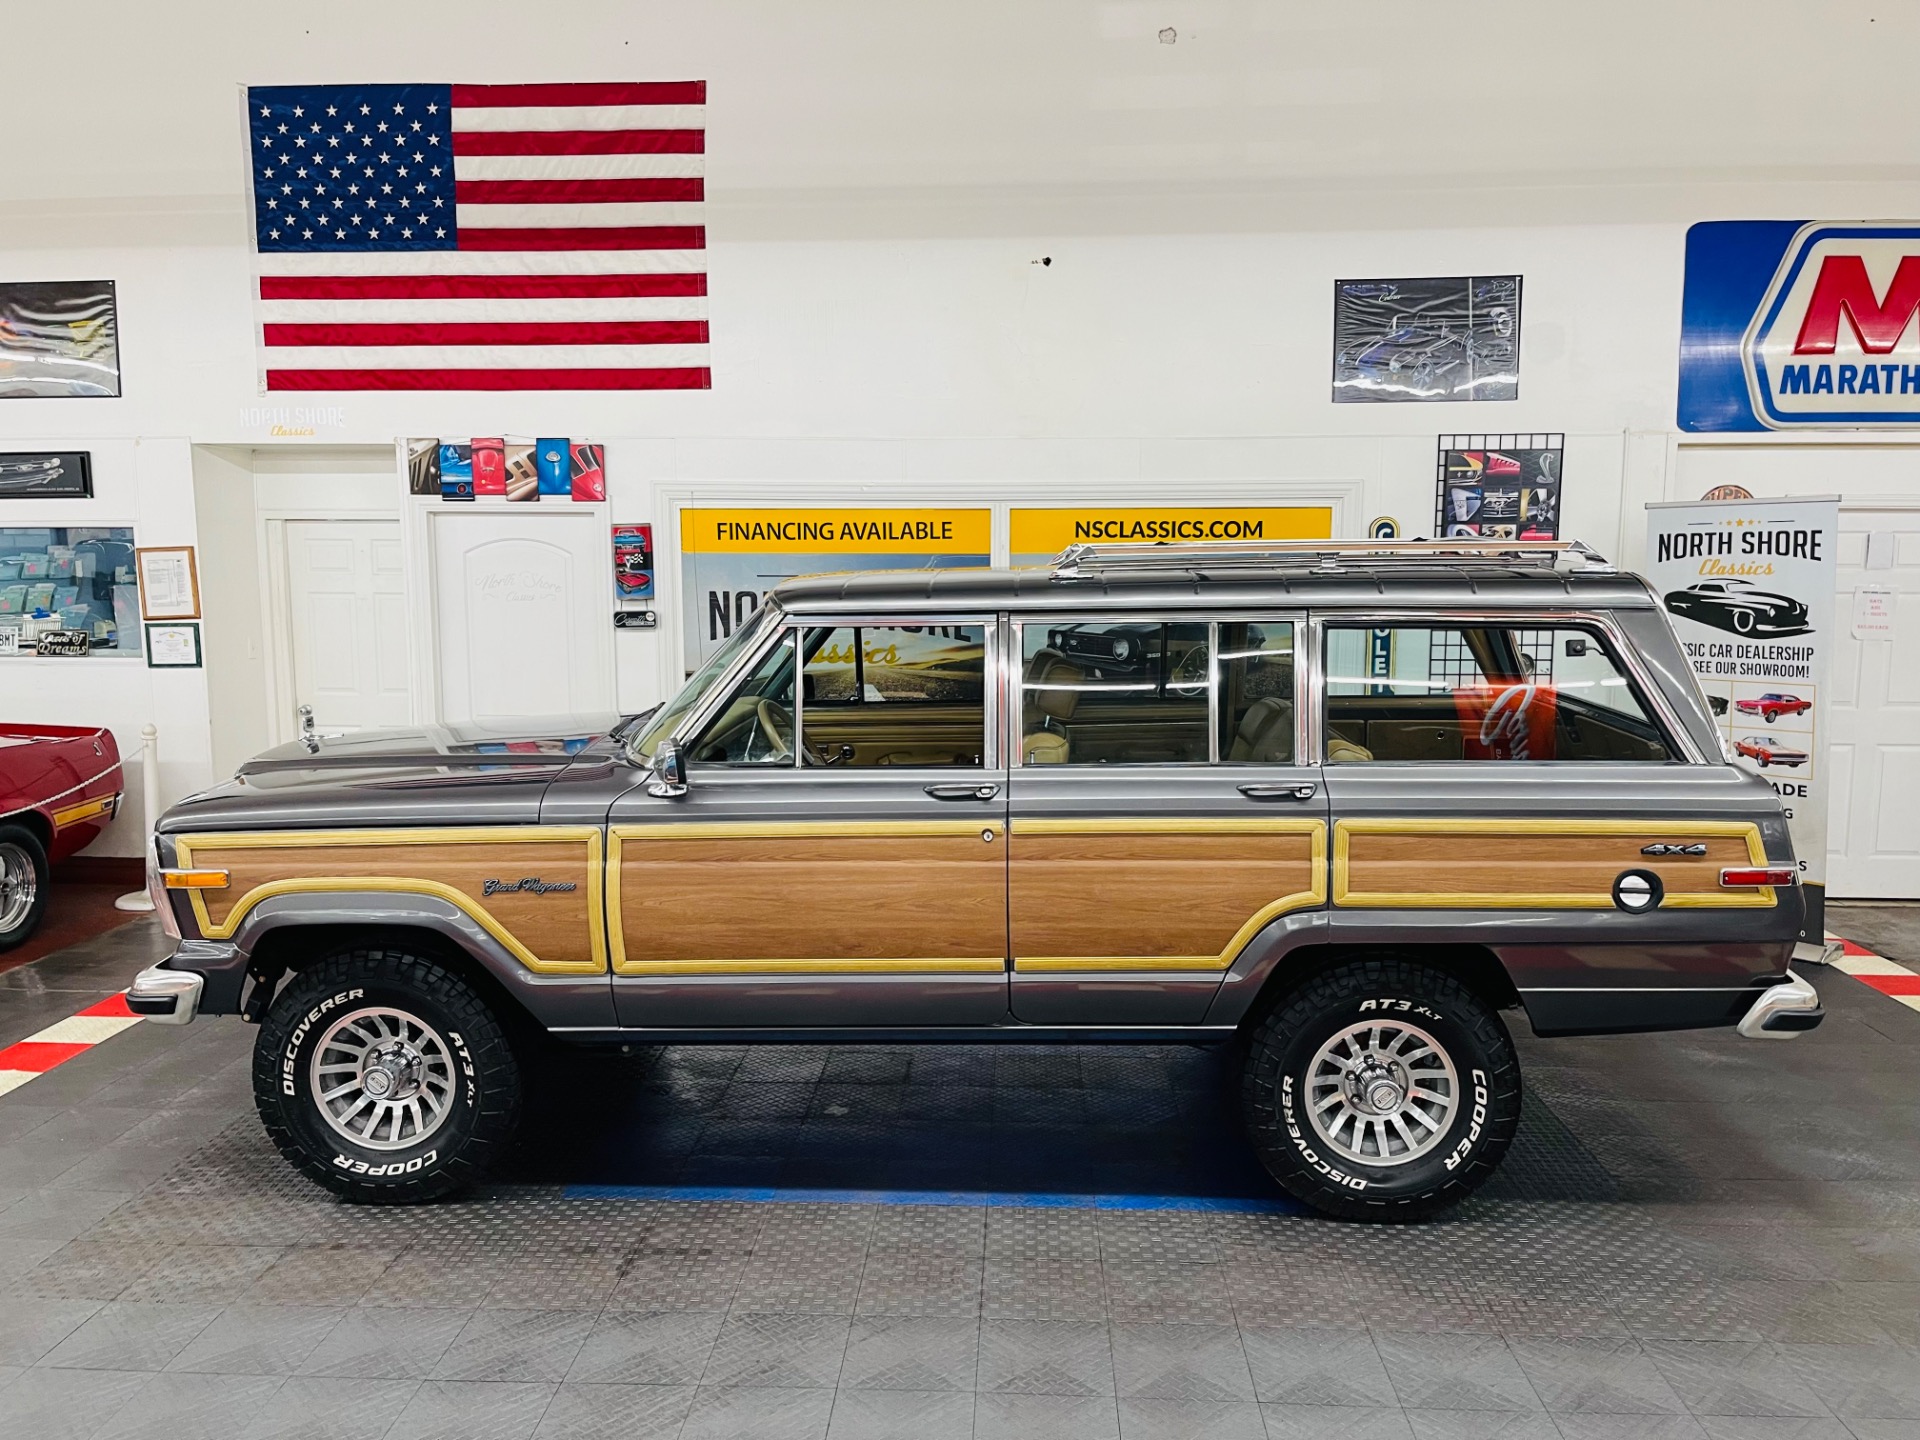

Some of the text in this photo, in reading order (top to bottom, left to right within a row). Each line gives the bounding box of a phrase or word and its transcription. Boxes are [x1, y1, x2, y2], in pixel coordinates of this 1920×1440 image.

[239, 406, 346, 428] NORTH SHORE
[270, 425, 316, 437] Classics
[716, 521, 953, 541] FINANCING AVAILABLE
[1075, 520, 1263, 539] NSCLASSICS.COM
[1657, 529, 1823, 563] NORTH SHORE
[1698, 558, 1776, 576] Classics
[38, 643, 87, 655] Dreams
[1709, 643, 1733, 659] CAR
[1736, 645, 1815, 662] DEALERSHIP
[1693, 660, 1810, 679] SEE OUR SHOWROOM!
[482, 878, 576, 896] Grand Wagoneer
[1359, 998, 1443, 1020] AT3 XLT
[282, 988, 364, 1096] DISCOVERER
[448, 1031, 476, 1108] AT3 XLT
[1443, 1068, 1488, 1172] COOPER
[1281, 1074, 1369, 1192] DISCOVERER
[333, 1149, 438, 1177] COOPER
